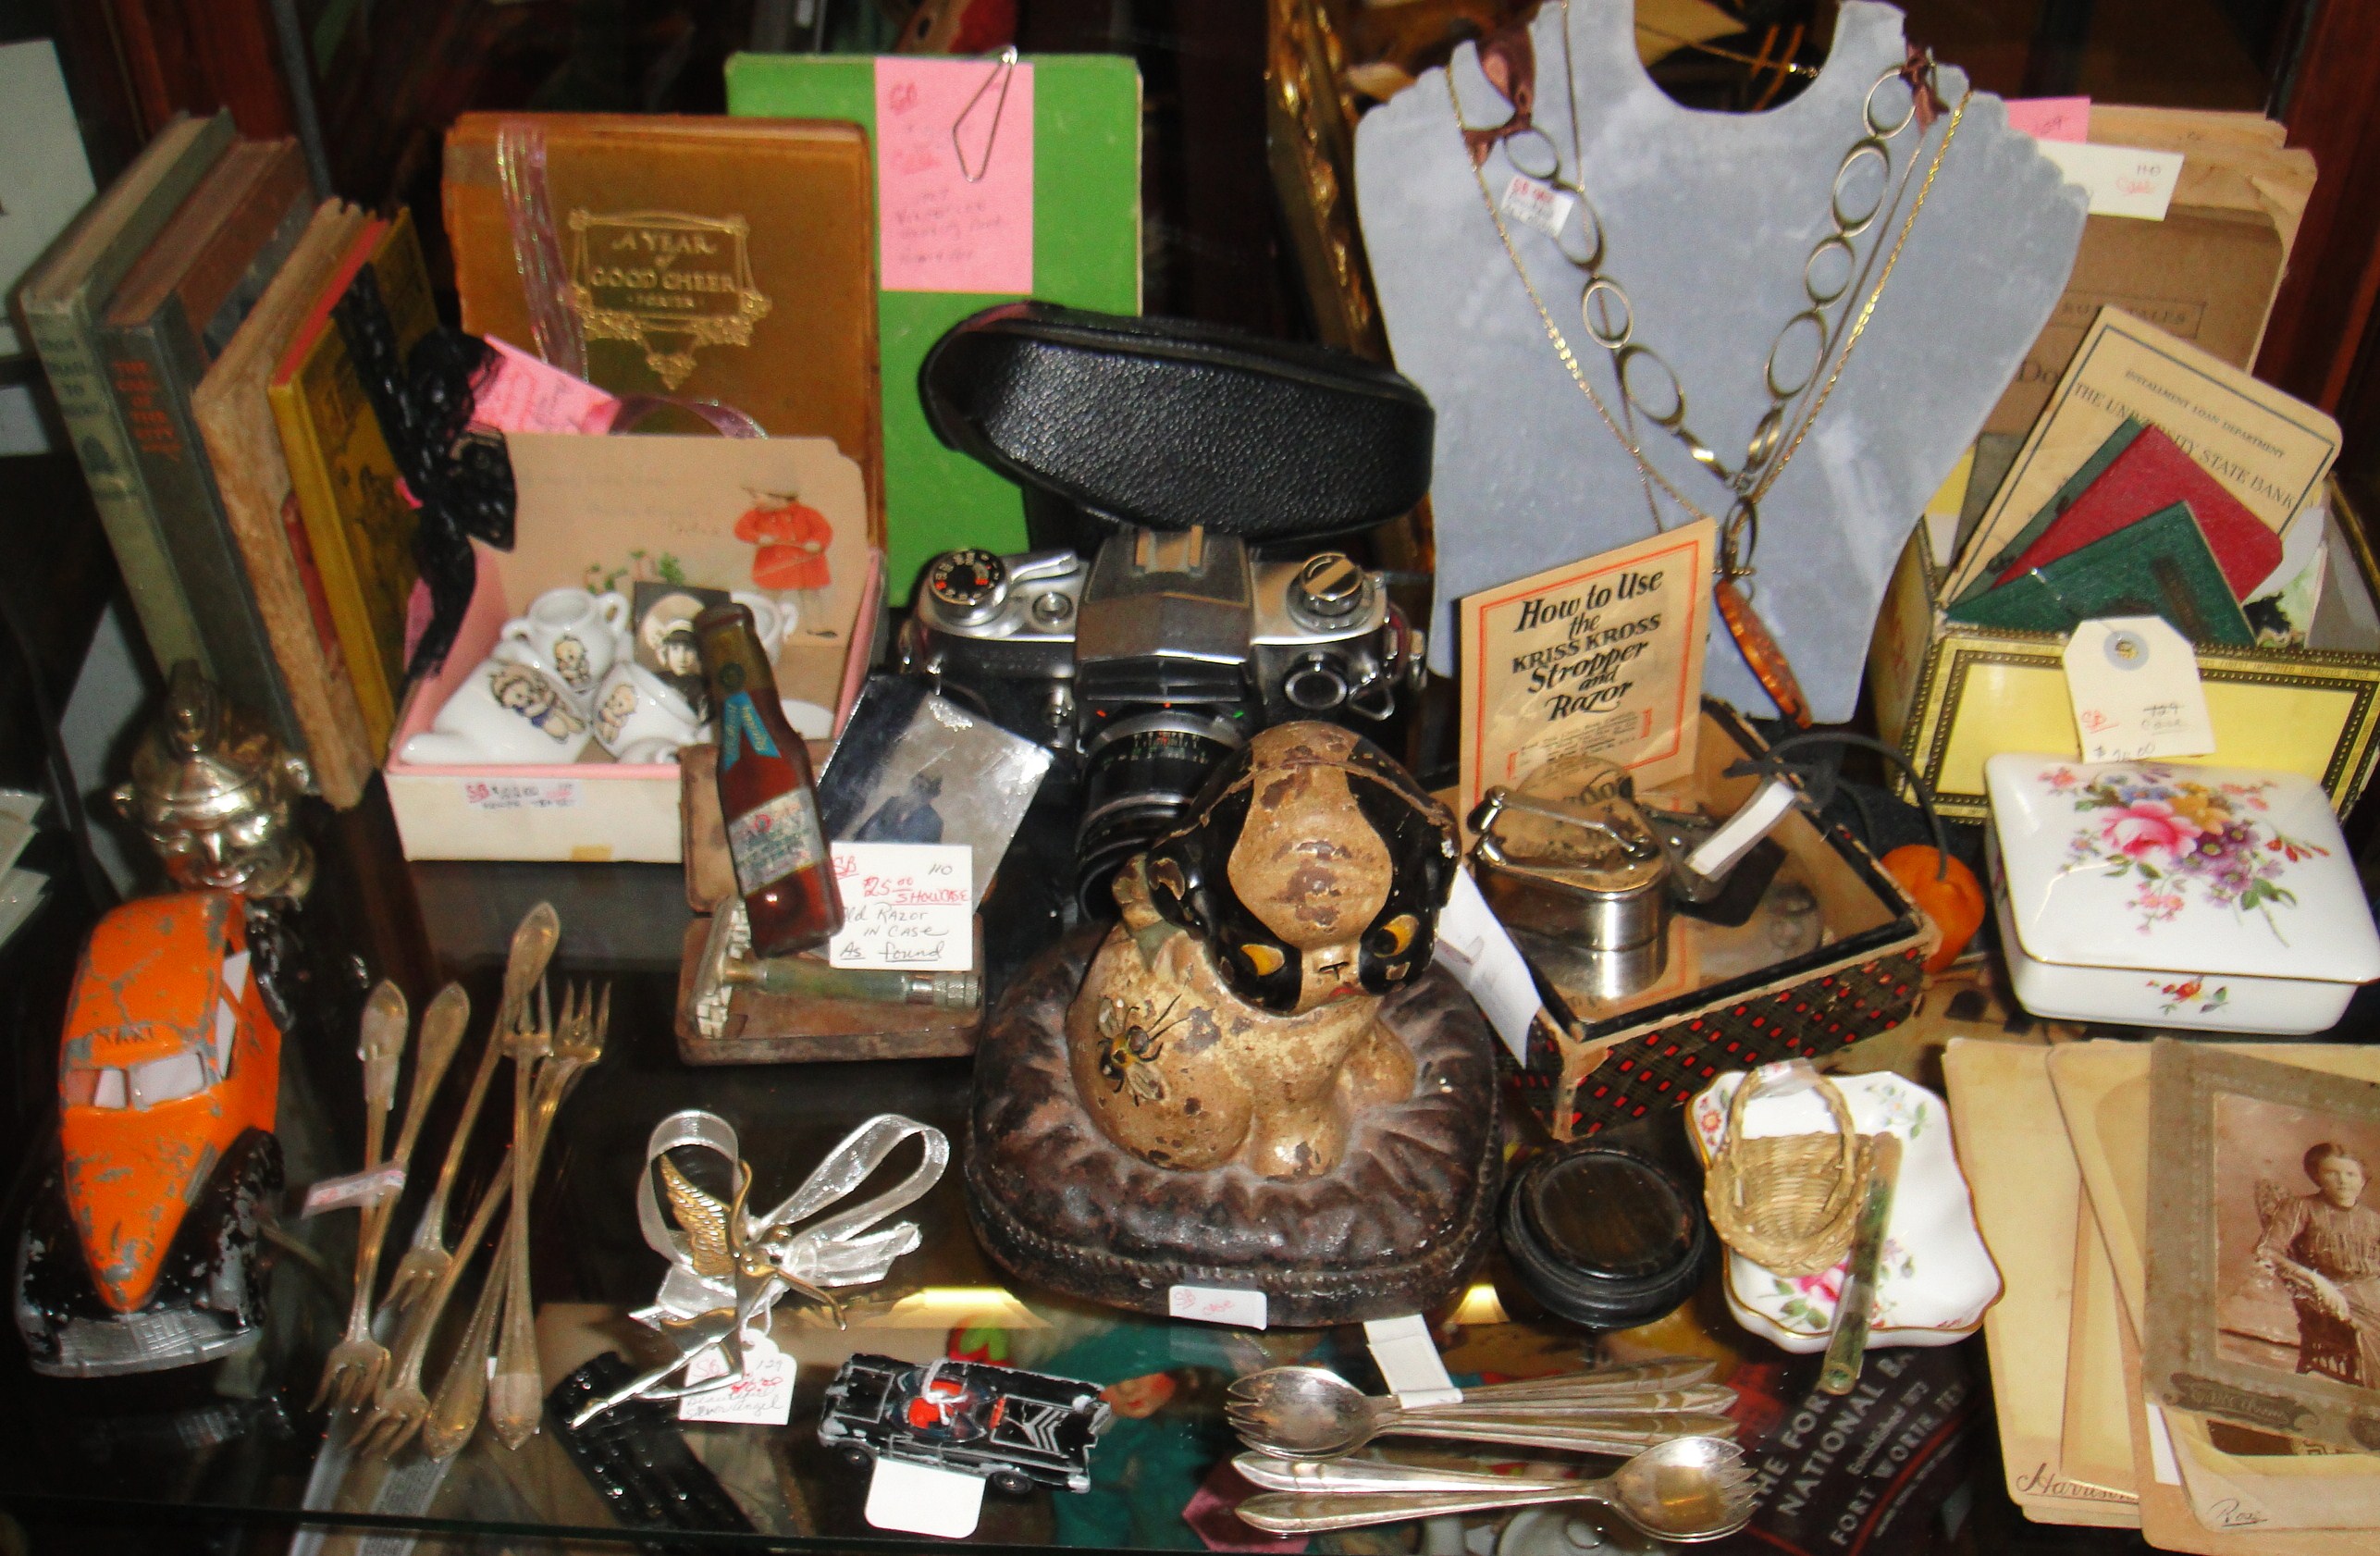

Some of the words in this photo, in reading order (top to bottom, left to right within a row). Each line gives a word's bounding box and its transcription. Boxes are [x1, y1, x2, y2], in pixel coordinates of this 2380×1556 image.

[611, 233, 637, 250] A
[590, 266, 658, 289] GOOD
[2075, 383, 2104, 408] THE
[2200, 449, 2249, 484] STATE
[2250, 475, 2298, 510] BANK
[2192, 404, 2221, 426] LOAN
[2222, 419, 2286, 459] DEPARTMENT
[1513, 598, 1580, 633] How
[1586, 585, 1611, 611] to
[1618, 571, 1663, 599] Use
[1569, 613, 1600, 640] the
[1512, 638, 1582, 673] KRISS
[1585, 613, 1661, 651] KROSS
[1526, 640, 1649, 694] Stropper
[1546, 681, 1634, 722] Razor
[1578, 665, 1618, 692] and
[844, 906, 868, 921] ld
[840, 942, 862, 957] As
[879, 941, 944, 960] found
[1780, 1395, 1831, 1450] FOR
[1776, 1384, 1886, 1517] NATIONAL
[1829, 1487, 1878, 1546] FORT
